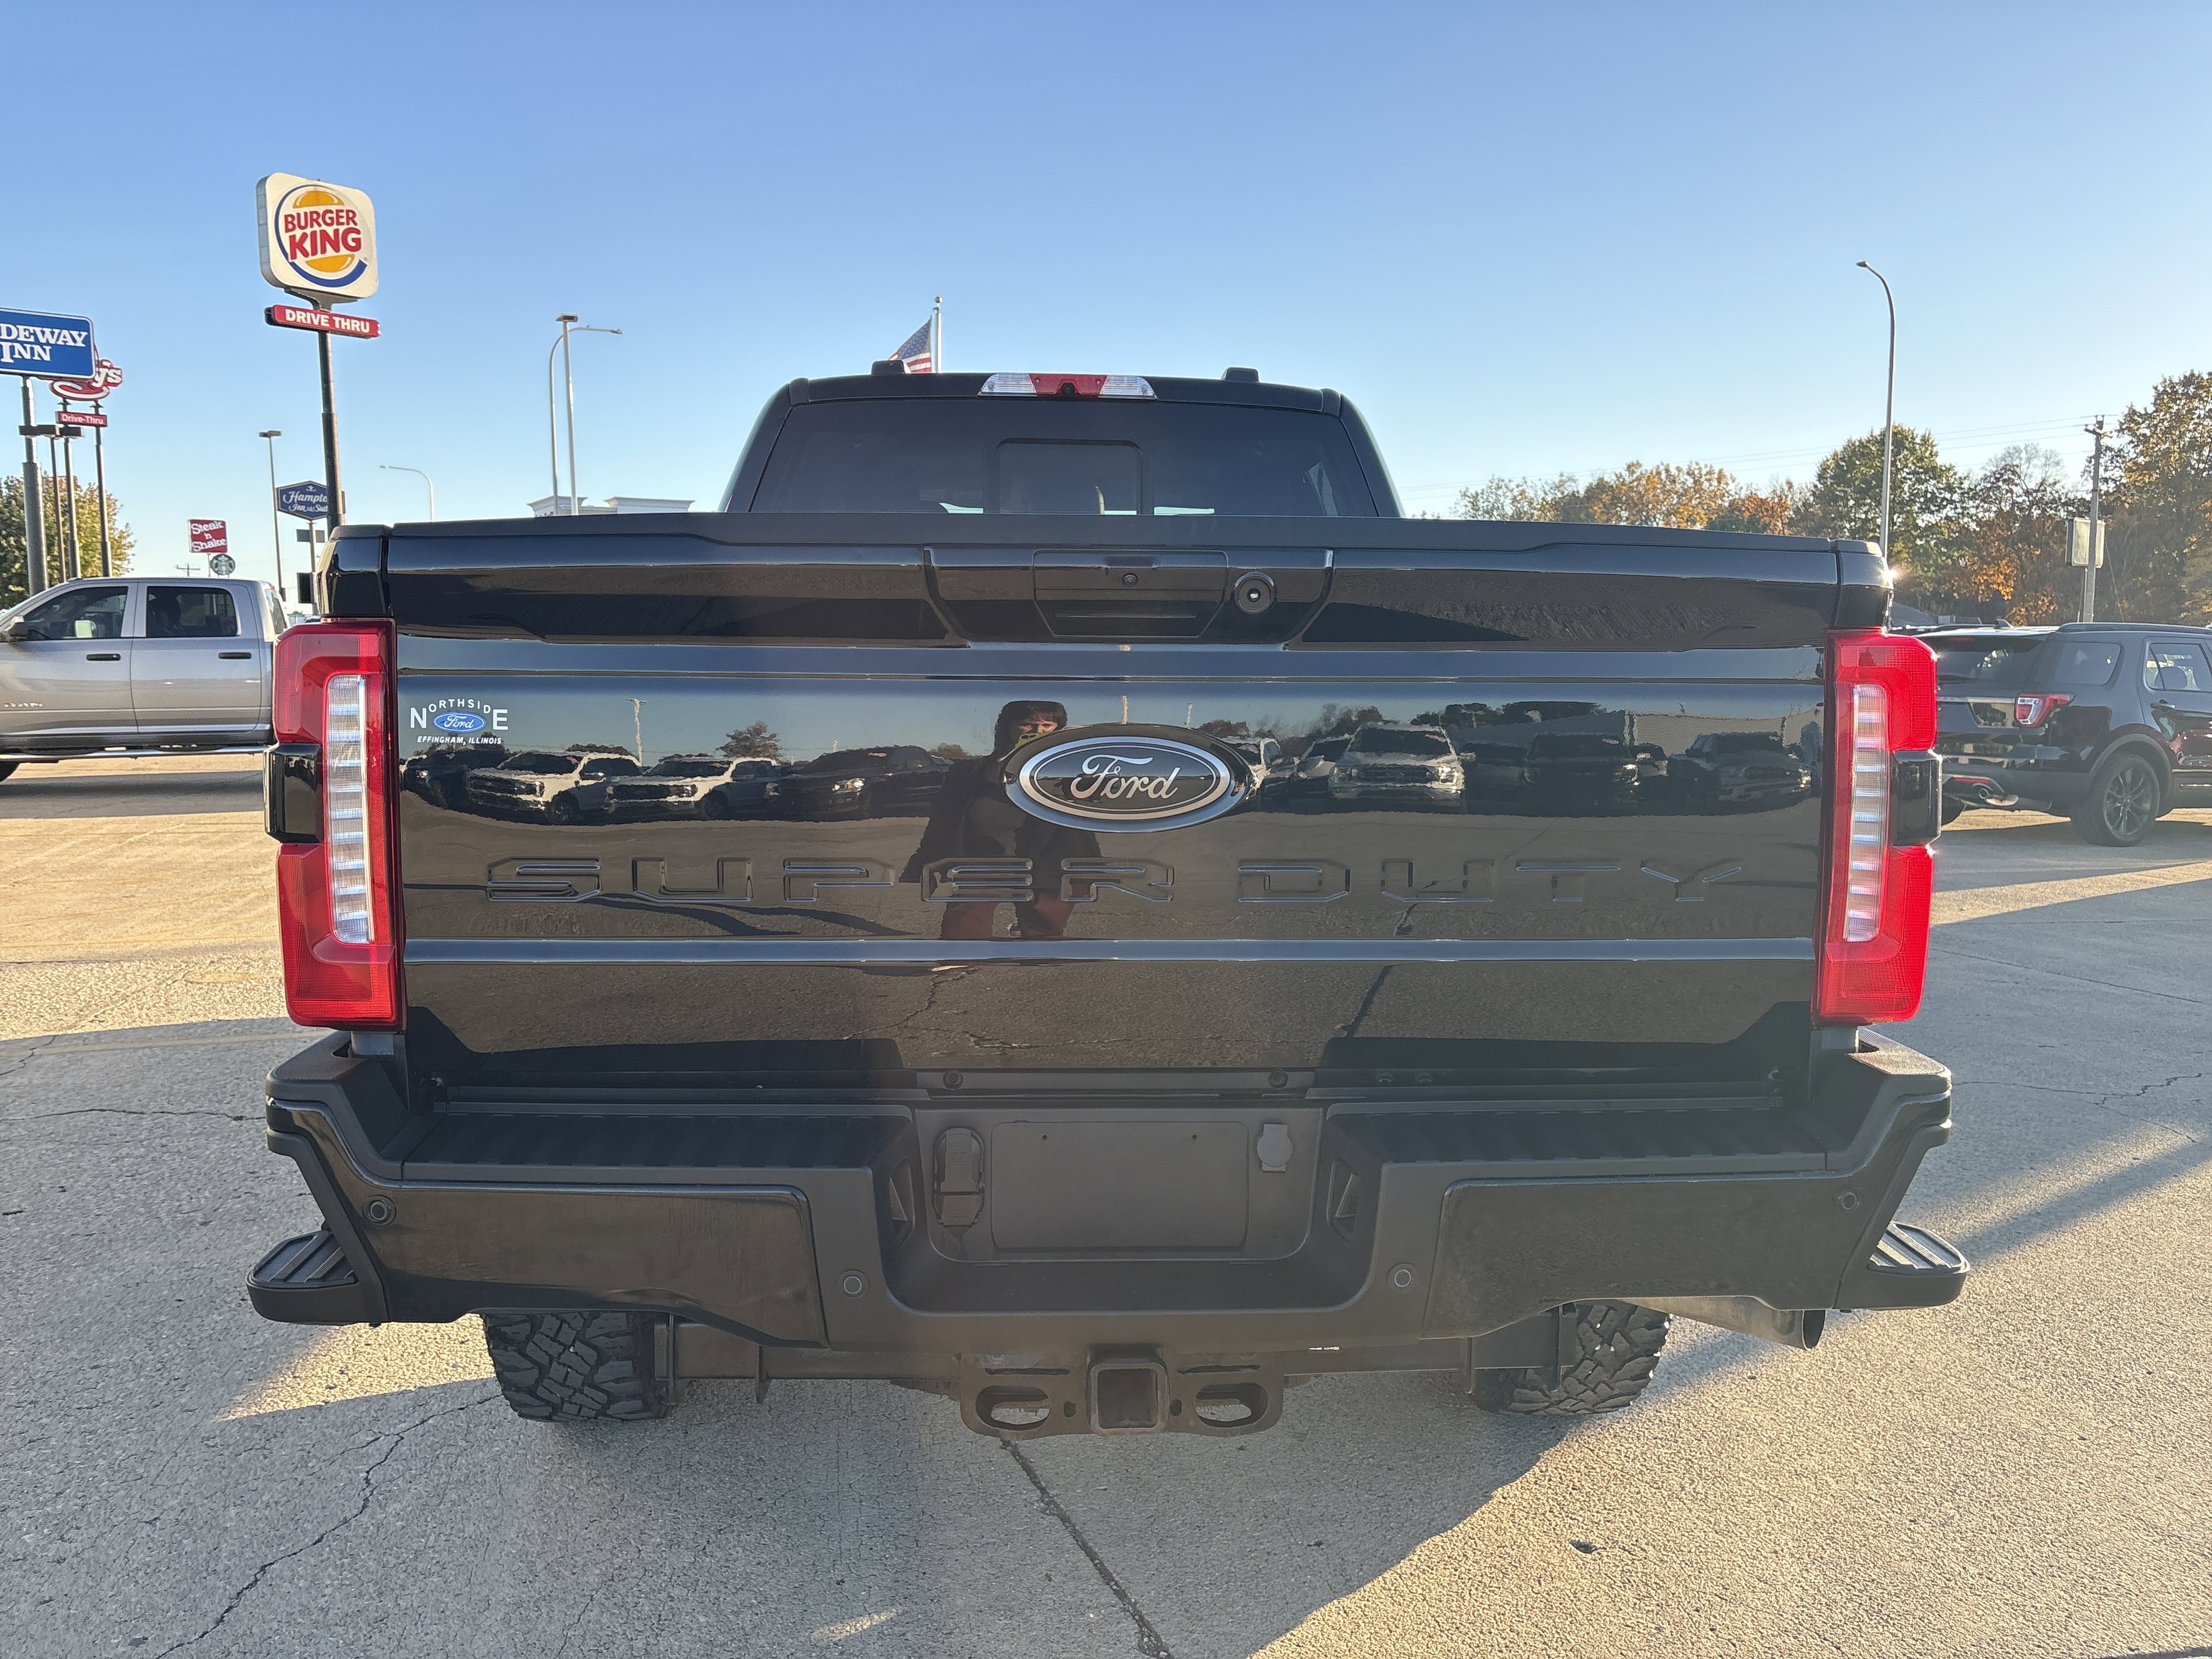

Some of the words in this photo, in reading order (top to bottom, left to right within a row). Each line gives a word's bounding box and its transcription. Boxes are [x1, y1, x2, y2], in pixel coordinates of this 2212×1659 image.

[284, 209, 358, 233] BURGER
[289, 227, 362, 261] KING
[284, 308, 330, 328] DRIVE
[332, 316, 370, 333] THRU
[0, 323, 88, 347] DEWAY
[1, 342, 52, 363] INN
[61, 413, 104, 424] Drive-Thru
[283, 491, 328, 504] Hampto
[289, 504, 307, 512] Inn
[313, 504, 329, 512] Suit
[191, 521, 224, 535] Steak
[192, 538, 227, 552] Shake
[410, 698, 509, 731] NORTHSIDE
[443, 714, 475, 729] Ford
[417, 736, 466, 746] EFFINGHAM,
[468, 736, 502, 745] ILLINOIS
[1070, 754, 1181, 799] Ford
[487, 856, 1175, 902] SUPER
[1238, 857, 1742, 902] DUTY
